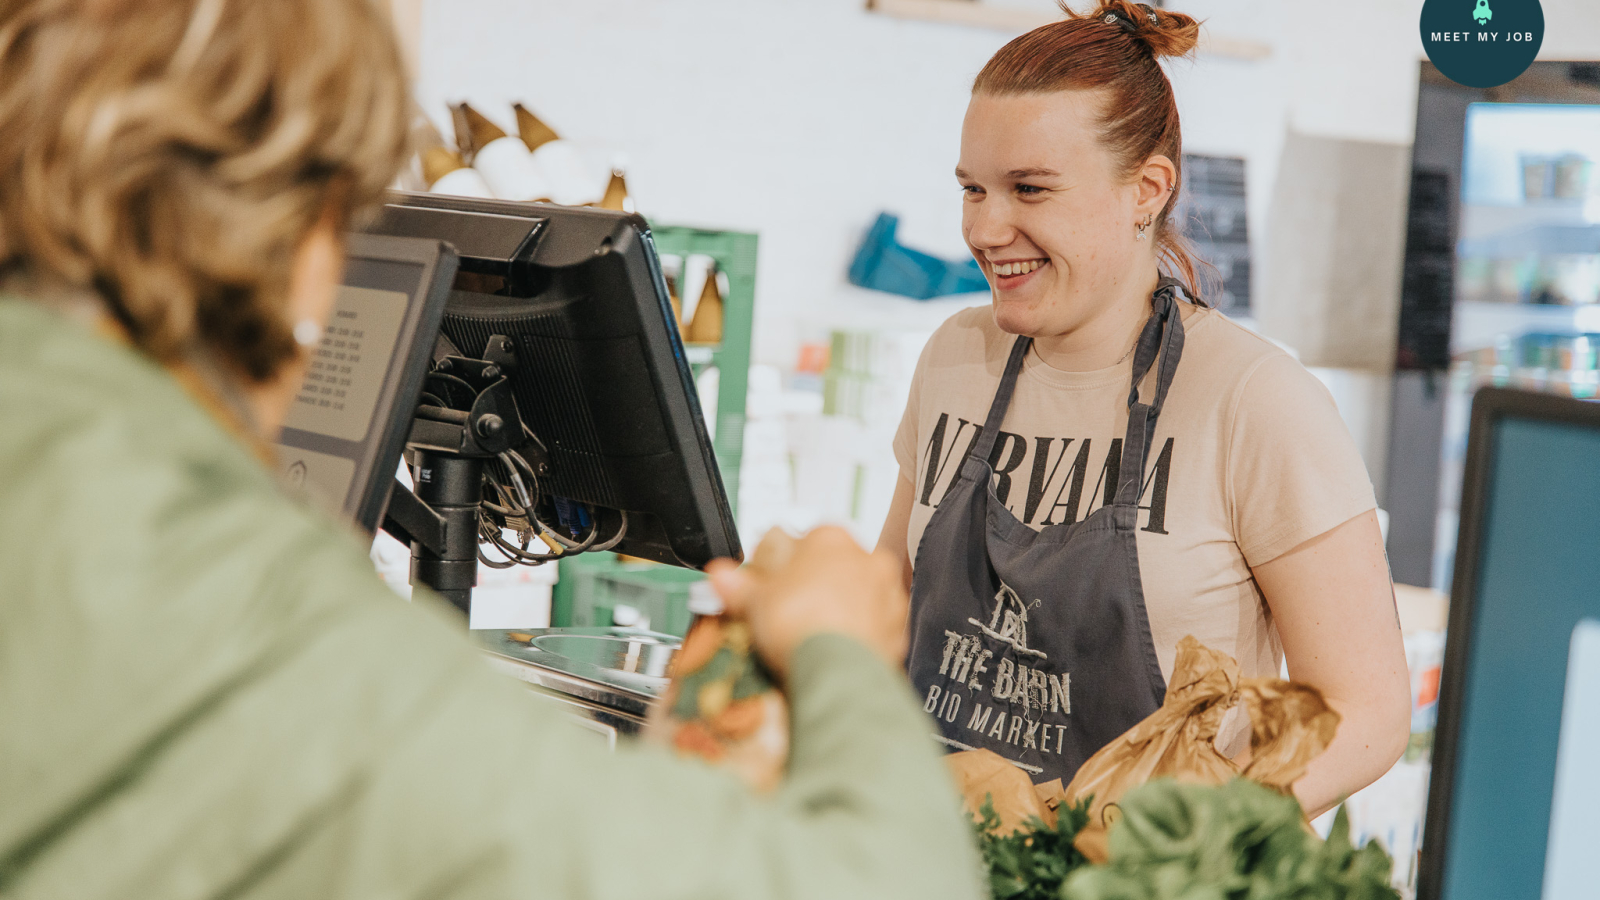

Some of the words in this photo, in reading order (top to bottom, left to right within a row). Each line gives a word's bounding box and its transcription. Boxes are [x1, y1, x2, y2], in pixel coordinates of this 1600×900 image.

[939, 629, 993, 692] THE
[992, 656, 1071, 715] BARN
[923, 684, 962, 723] BIO
[966, 703, 1067, 755] MARKET
